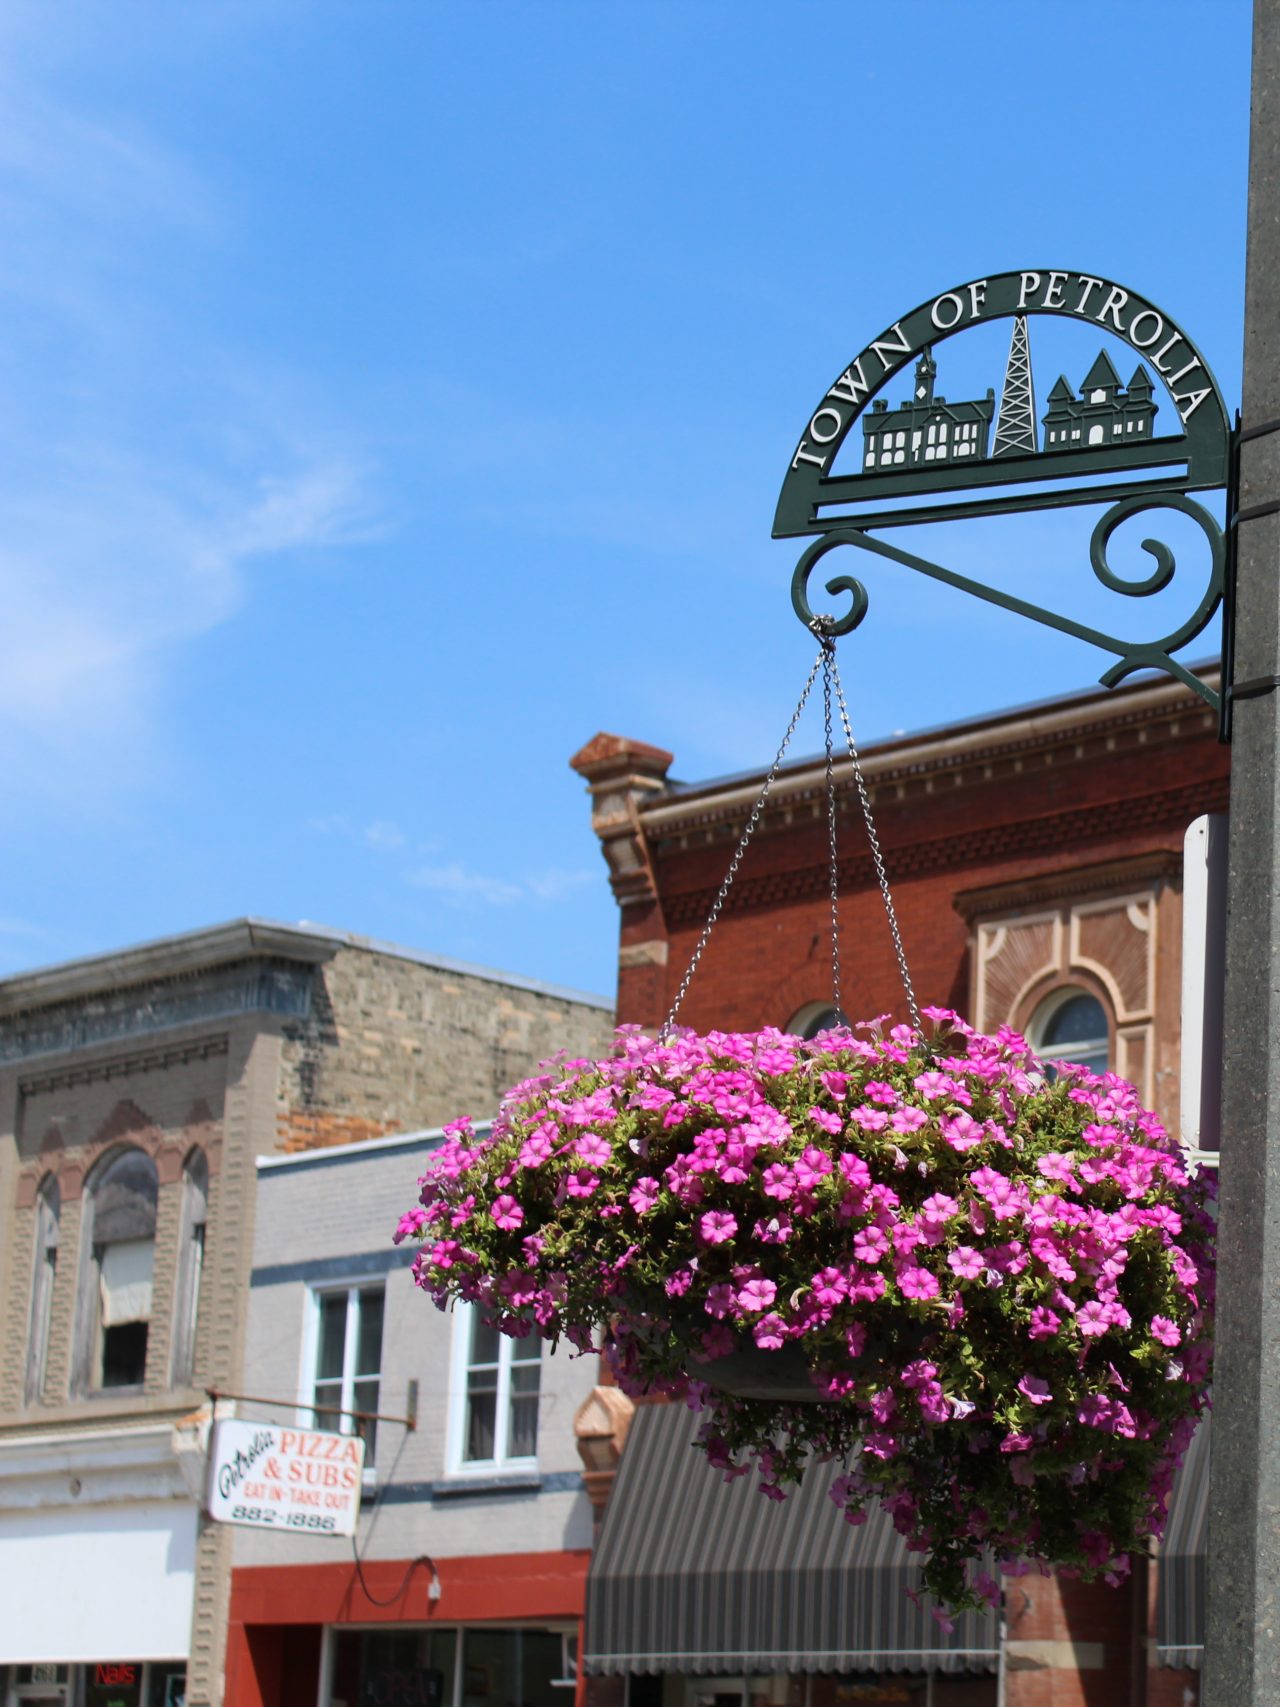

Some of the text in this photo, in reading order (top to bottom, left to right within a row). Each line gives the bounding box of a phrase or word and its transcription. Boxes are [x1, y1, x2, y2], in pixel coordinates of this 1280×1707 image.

[792, 271, 1212, 471] TOWN OF PETROLIA
[280, 1431, 359, 1464] PIZZA
[263, 1457, 357, 1489] & SUBS
[244, 1482, 266, 1499] EAT
[324, 1493, 349, 1510] OUT
[95, 1663, 137, 1686] Nails
